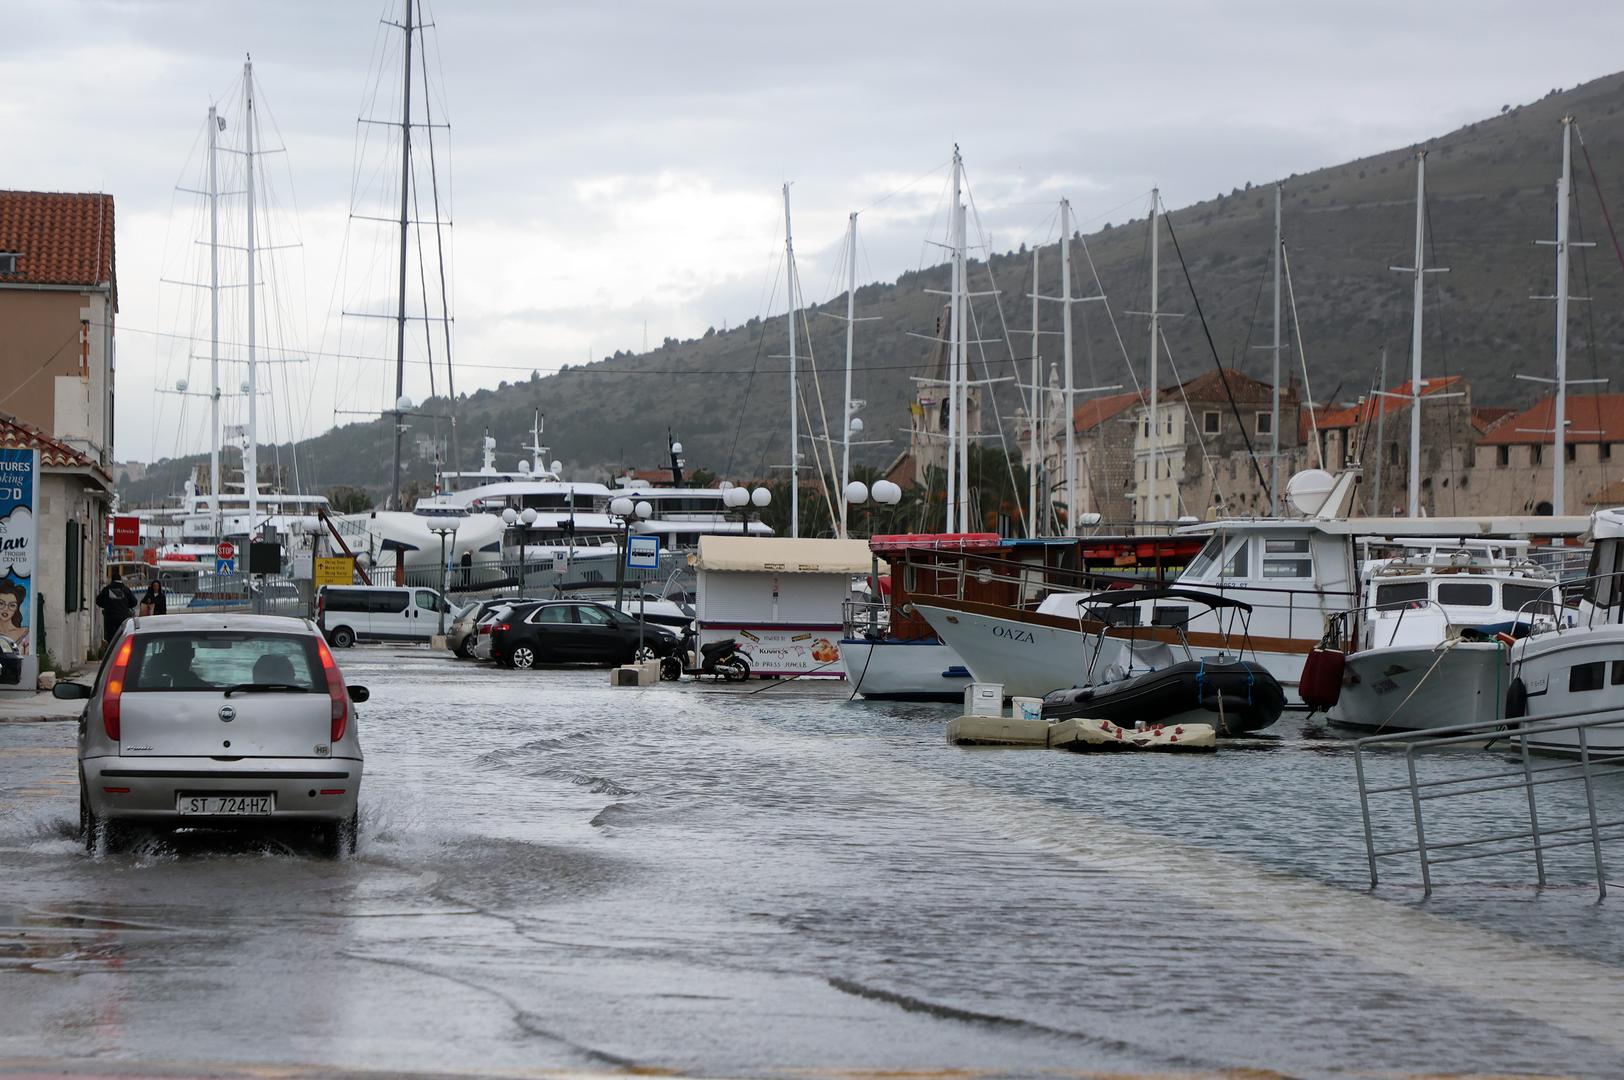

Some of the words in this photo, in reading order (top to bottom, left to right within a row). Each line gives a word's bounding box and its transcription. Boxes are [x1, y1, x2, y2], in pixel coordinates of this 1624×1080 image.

[0, 472, 24, 487] king
[218, 546, 234, 555] STOP
[992, 625, 1035, 644] OAZA
[191, 798, 208, 812] ST
[219, 798, 268, 812] 724-HZ
